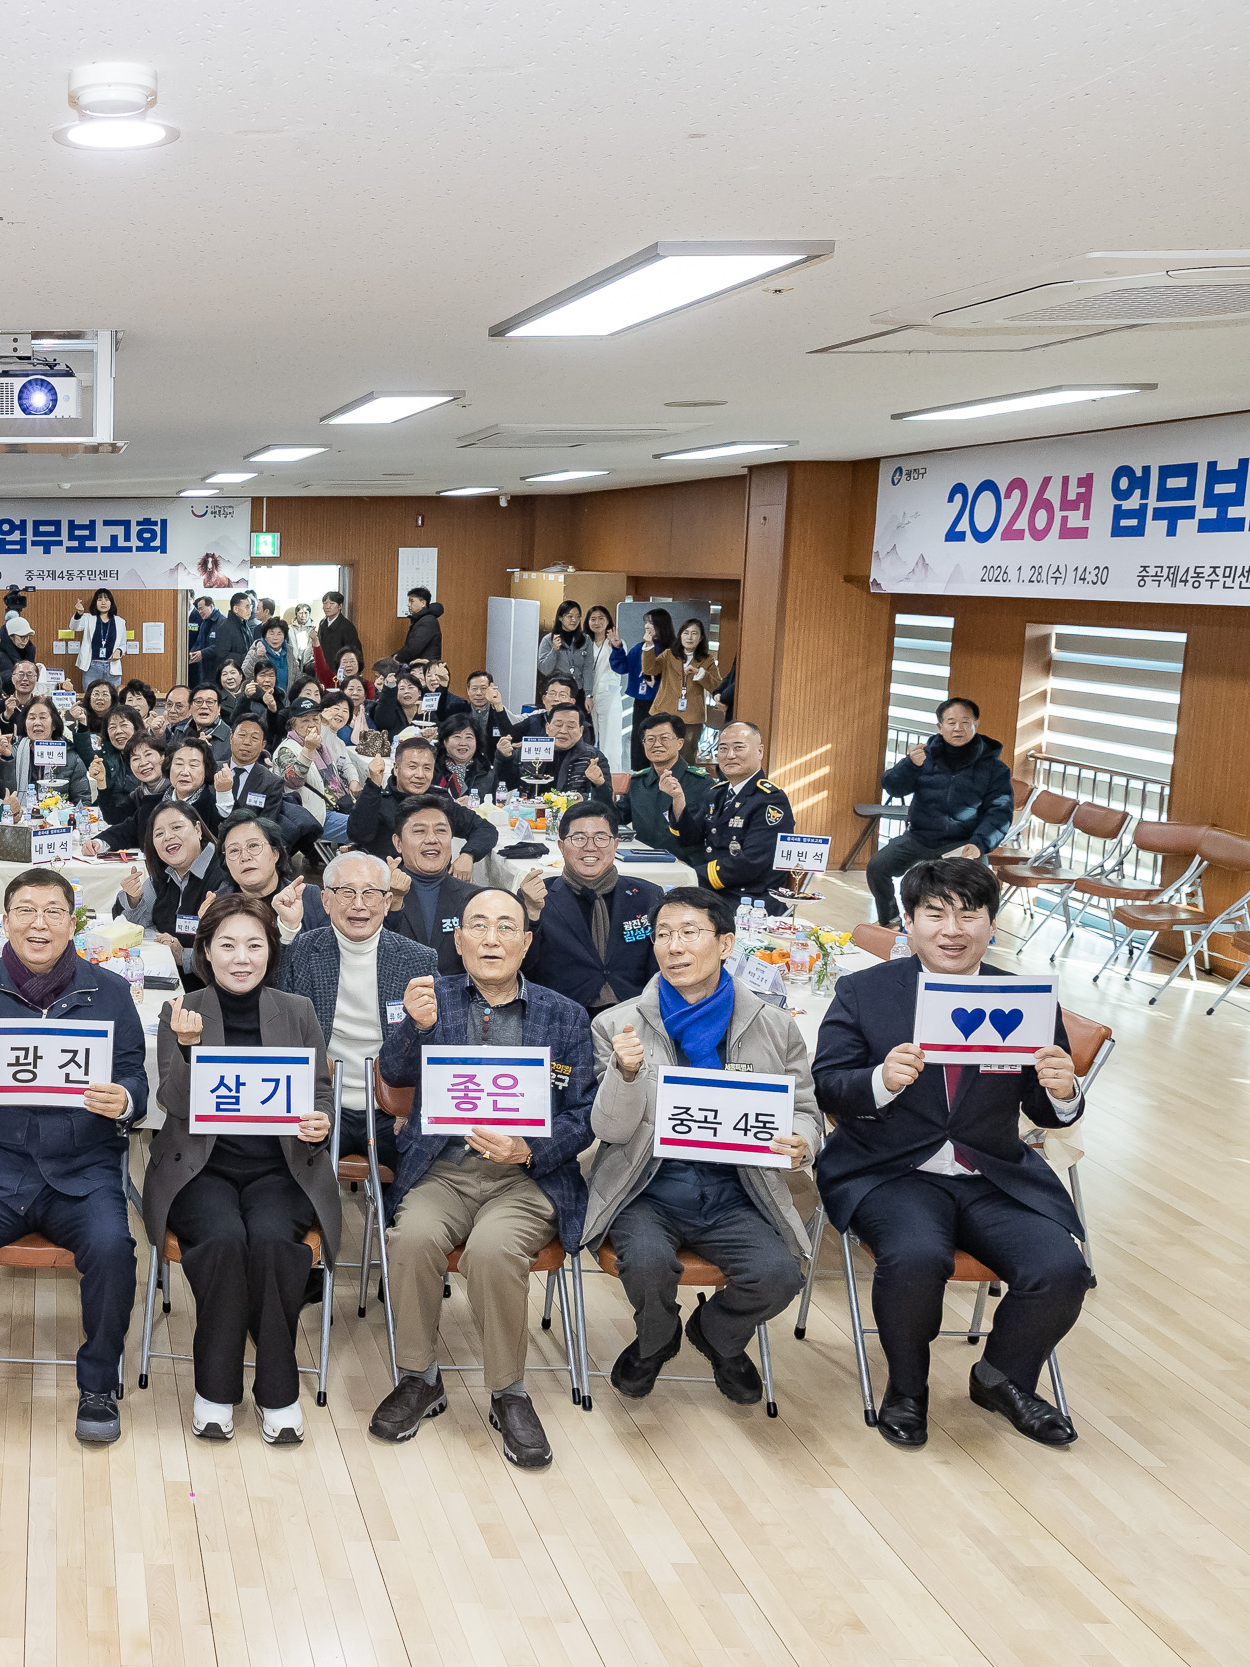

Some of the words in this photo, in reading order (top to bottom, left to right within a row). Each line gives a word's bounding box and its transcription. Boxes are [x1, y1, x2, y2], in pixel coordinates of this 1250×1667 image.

[904, 467, 927, 482] 광진구
[944, 472, 1094, 543] 2026년
[1110, 458, 1250, 538] 업무보
[25, 569, 119, 582] 중곡제4동주민센터
[980, 565, 1012, 584] 2026.
[1017, 566, 1025, 584] 1.
[1028, 564, 1068, 586] 28.(수)
[1072, 566, 1110, 586] 14:30
[36, 750, 64, 760] 내빈석
[524, 746, 551, 756] 내빈석
[34, 840, 68, 856] 내빈석
[781, 849, 824, 865] 내빈석
[6, 1045, 91, 1085] 광진
[209, 1074, 292, 1114] 살기
[446, 1073, 525, 1113] 좋은
[667, 1105, 723, 1138] 중곡
[732, 1112, 781, 1143] 4동
